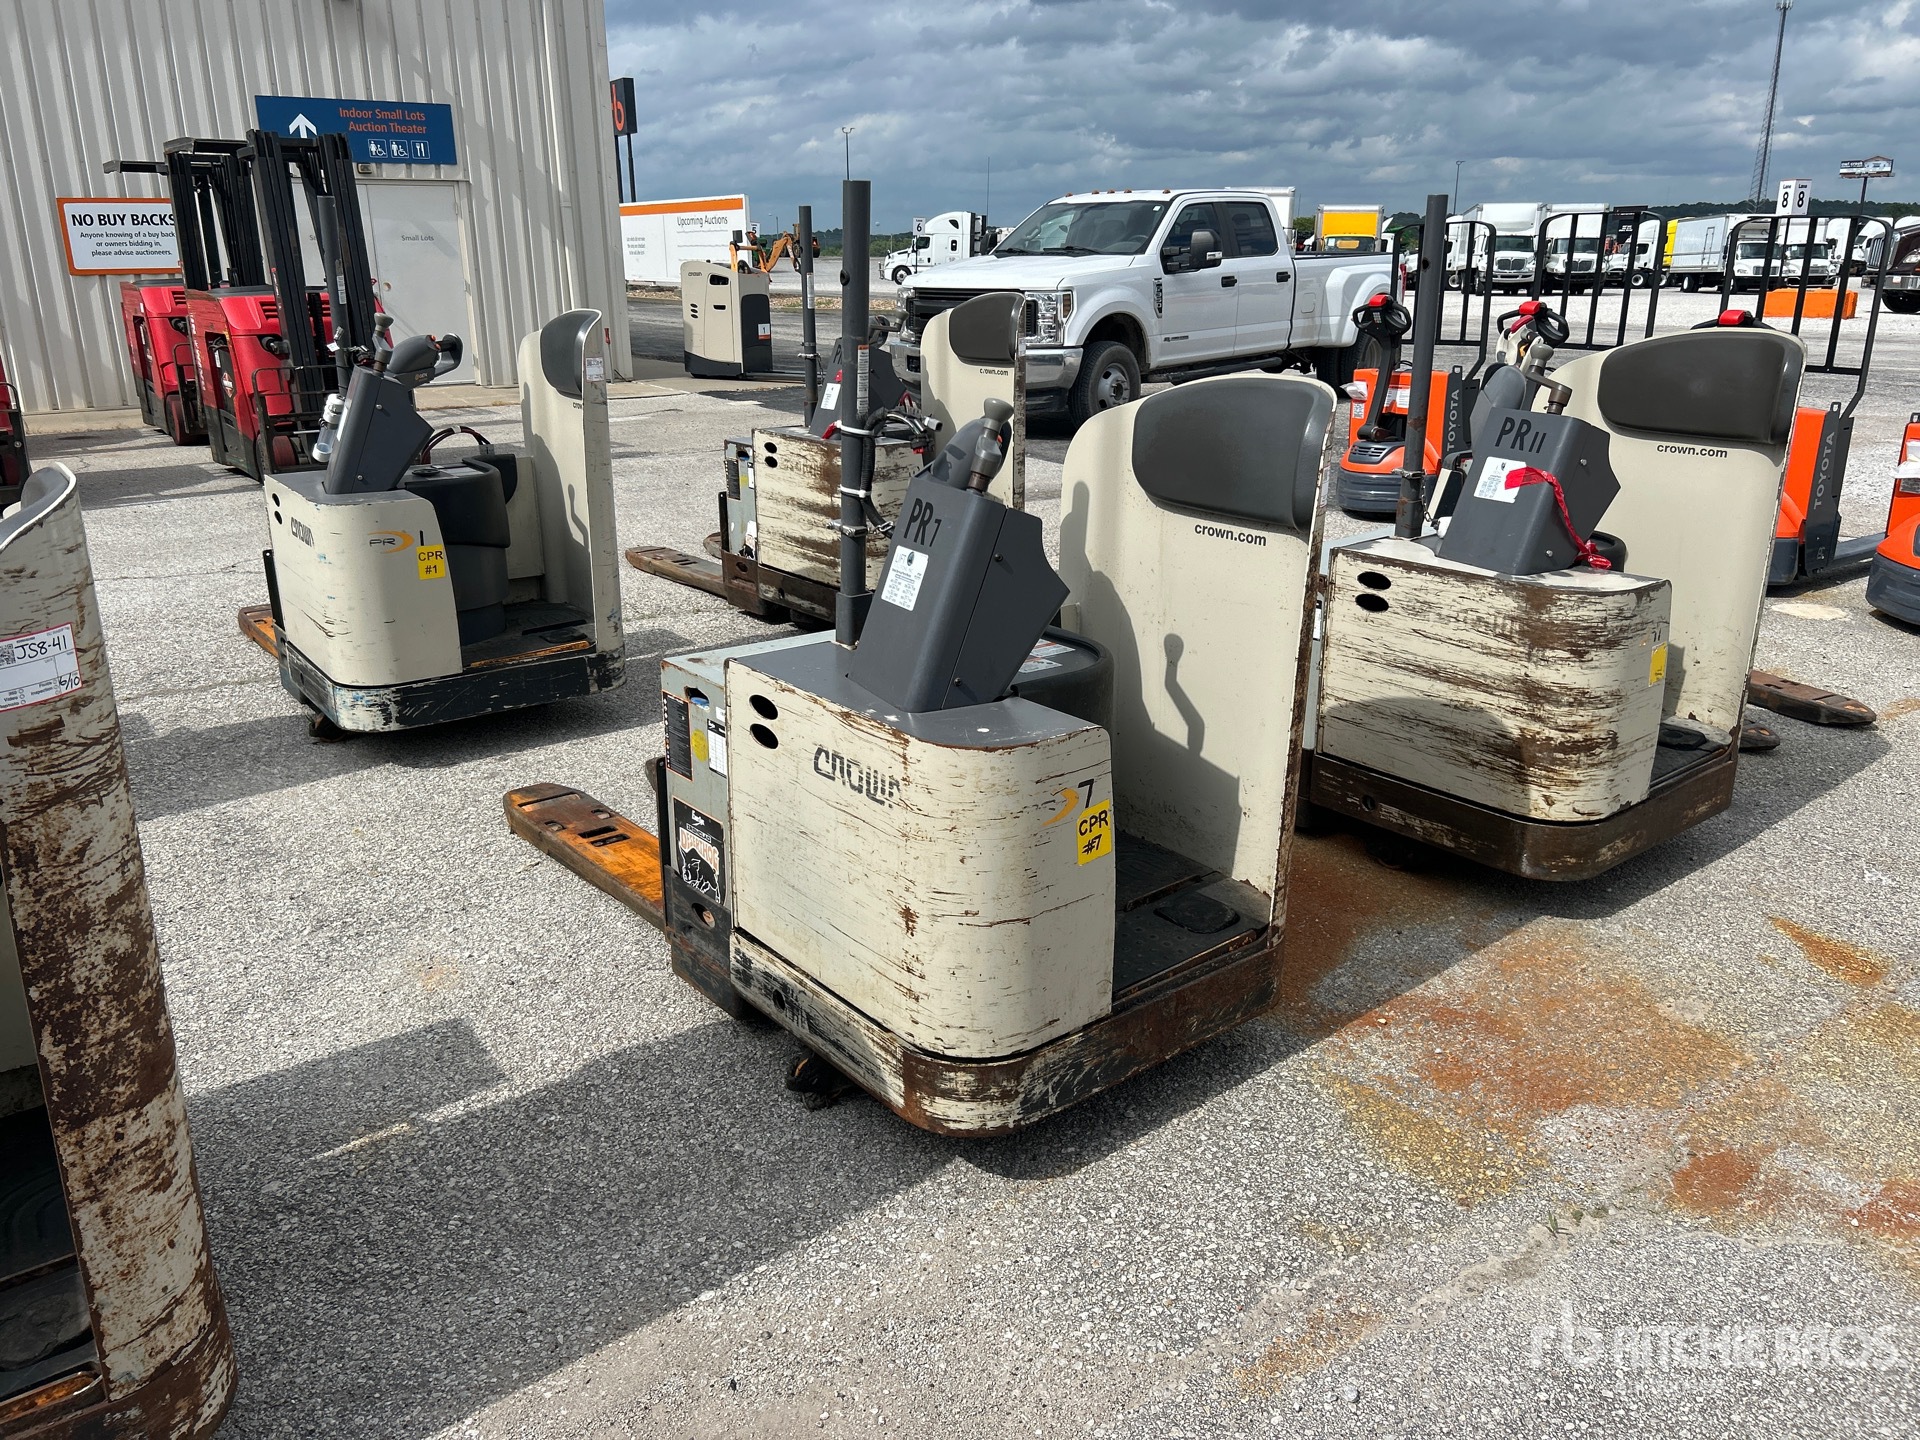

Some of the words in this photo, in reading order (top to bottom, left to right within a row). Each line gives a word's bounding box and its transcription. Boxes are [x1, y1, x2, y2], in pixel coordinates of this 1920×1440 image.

[339, 107, 373, 119] Indoor
[375, 109, 403, 120] Small
[405, 111, 426, 121] Lots
[348, 121, 387, 133] Auction
[389, 122, 427, 134] Theater
[1781, 191, 1789, 208] 8
[1797, 191, 1805, 208] 8
[71, 213, 94, 226] NO
[97, 213, 126, 226] BUY
[130, 213, 175, 226] BACKS
[677, 216, 704, 228] Upcoming
[704, 215, 728, 225] Auctions
[80, 231, 104, 240] Anyone
[105, 231, 133, 239] knowing
[916, 223, 923, 233] 6
[1446, 389, 1460, 452] TOYOTA
[1656, 444, 1728, 458] crown.com
[1813, 431, 1835, 510] TOYOTA
[1194, 524, 1267, 547] crown.com
[418, 550, 444, 562] CPR
[425, 564, 438, 575] #1
[14, 634, 67, 660] JS8-41
[1078, 778, 1095, 809] 7
[1078, 809, 1109, 837] CPR
[1082, 833, 1102, 855] #7
